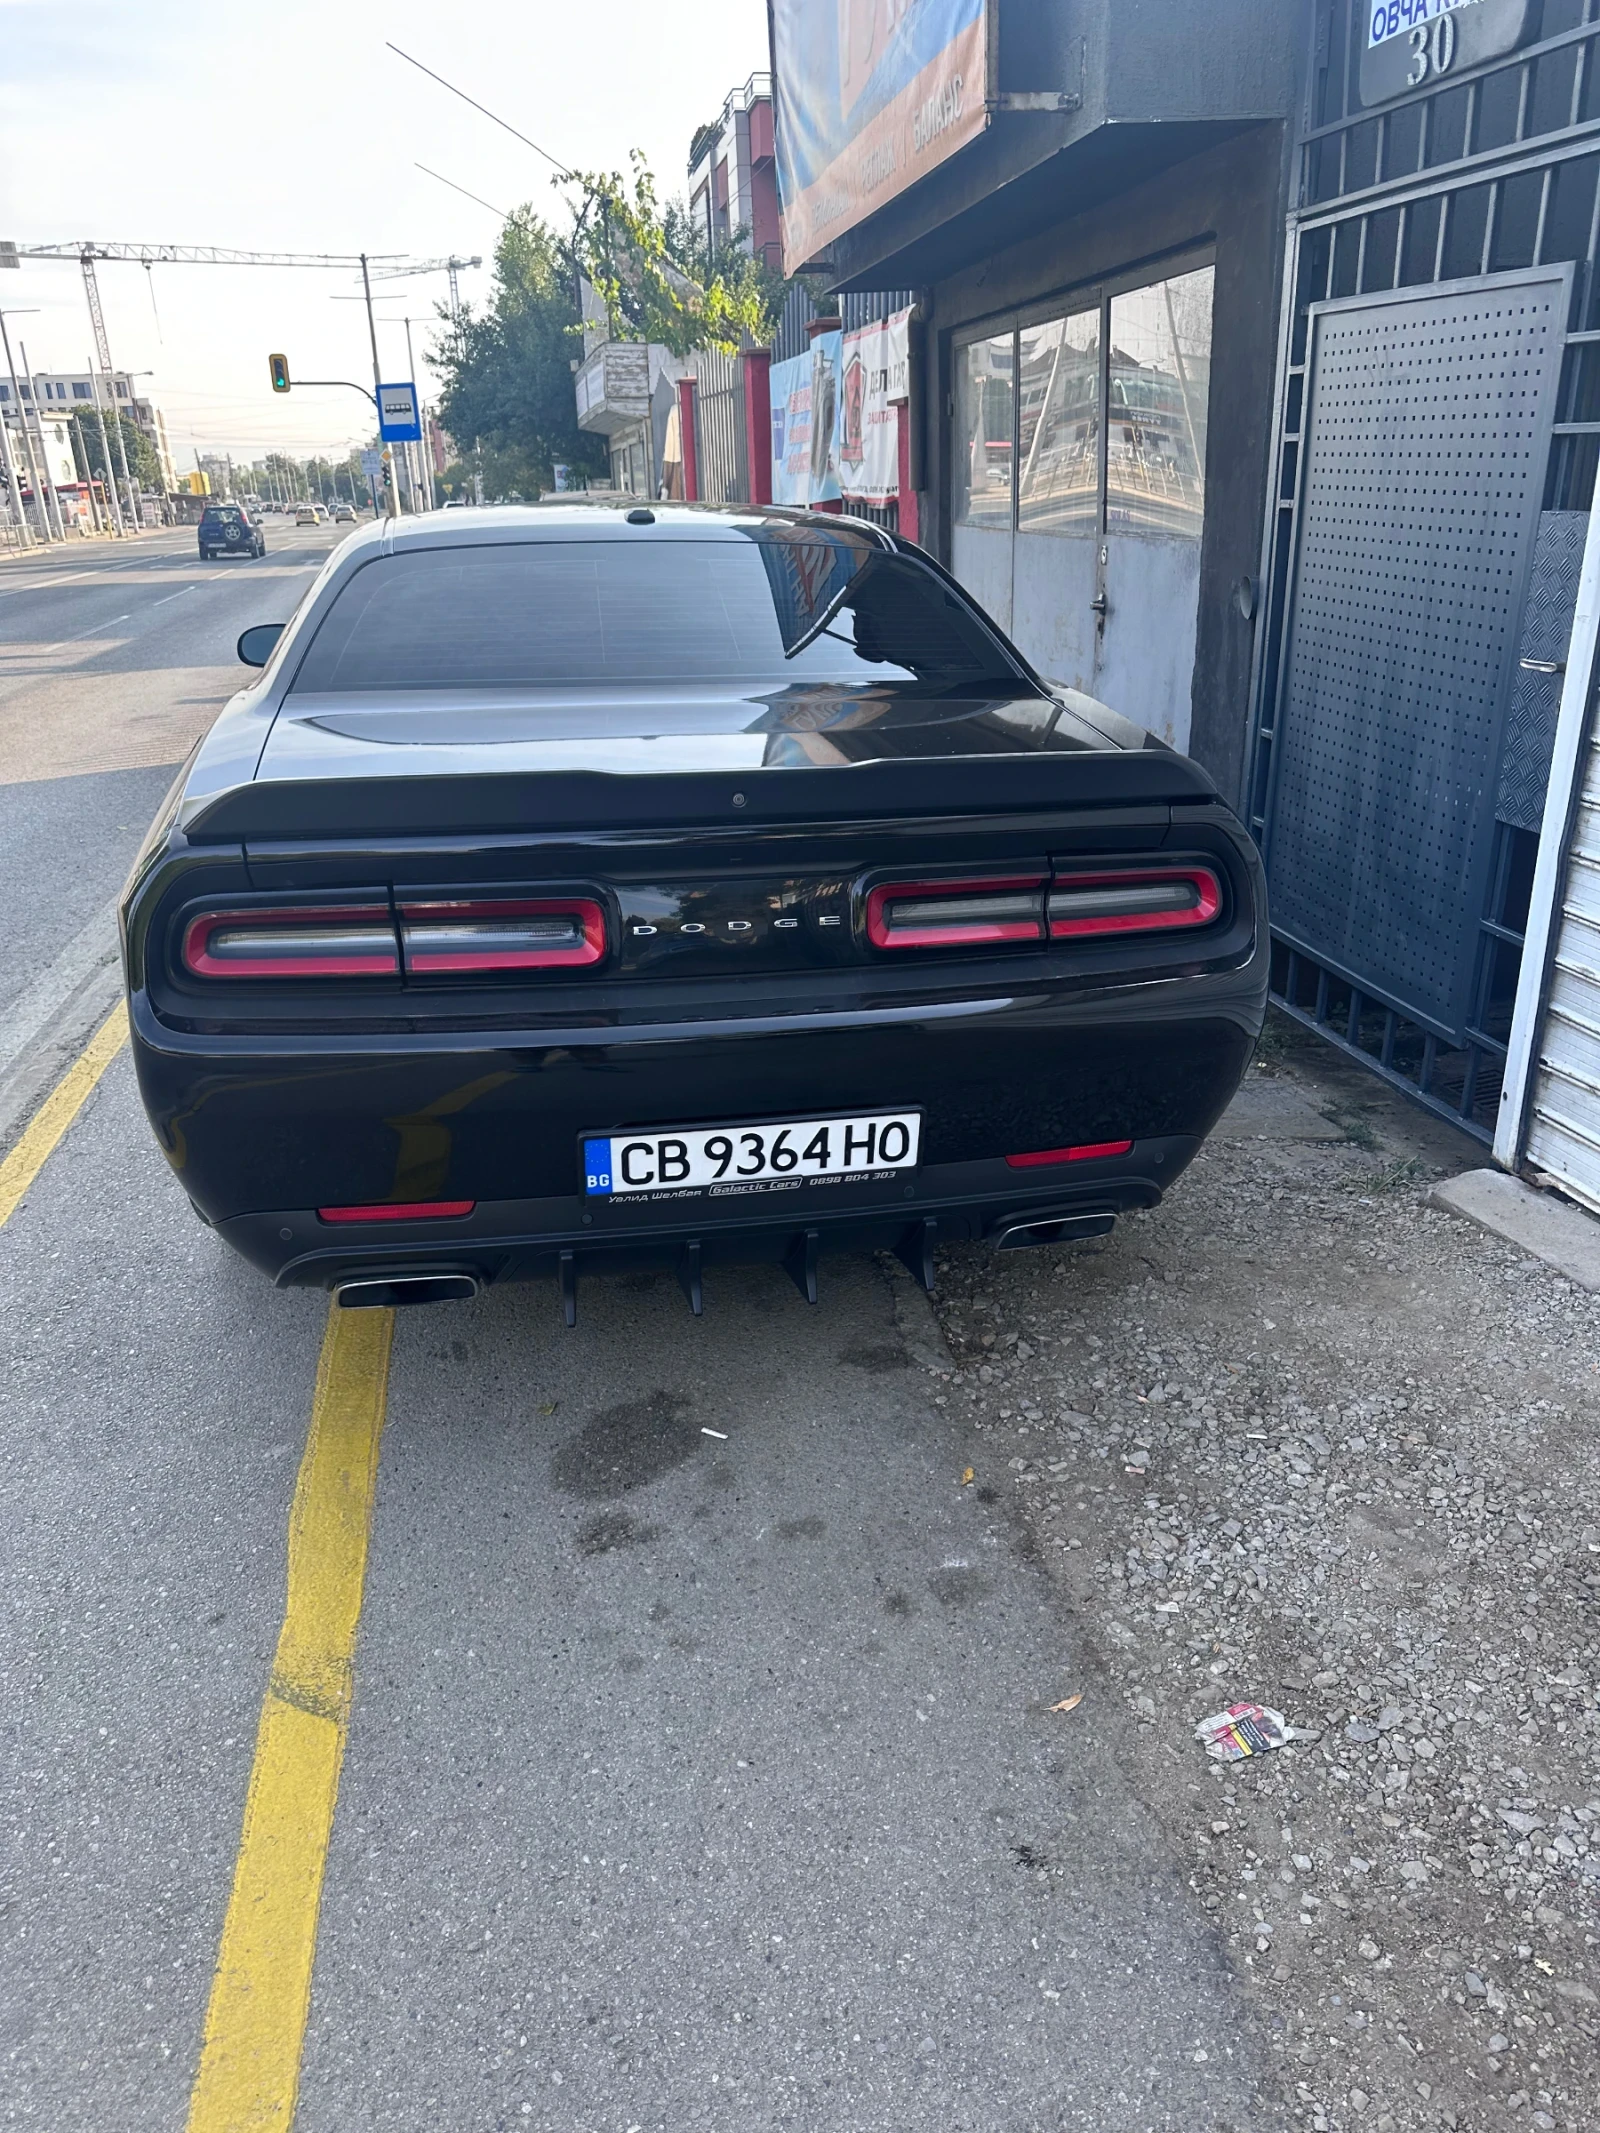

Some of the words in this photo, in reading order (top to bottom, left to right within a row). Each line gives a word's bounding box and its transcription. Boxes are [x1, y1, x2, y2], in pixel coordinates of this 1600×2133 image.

[1407, 14, 1454, 86] 30
[912, 73, 963, 153] БАЛАНС
[632, 915, 842, 936] DODGE
[620, 1138, 691, 1186] CB
[703, 1126, 832, 1178] 9364
[843, 1121, 910, 1167] HO
[586, 1173, 610, 1188] BG
[711, 1182, 766, 1195] Galactic
[769, 1180, 800, 1190] Cars
[809, 1176, 842, 1186] 0898
[844, 1174, 870, 1183] 804
[872, 1170, 897, 1180] 303
